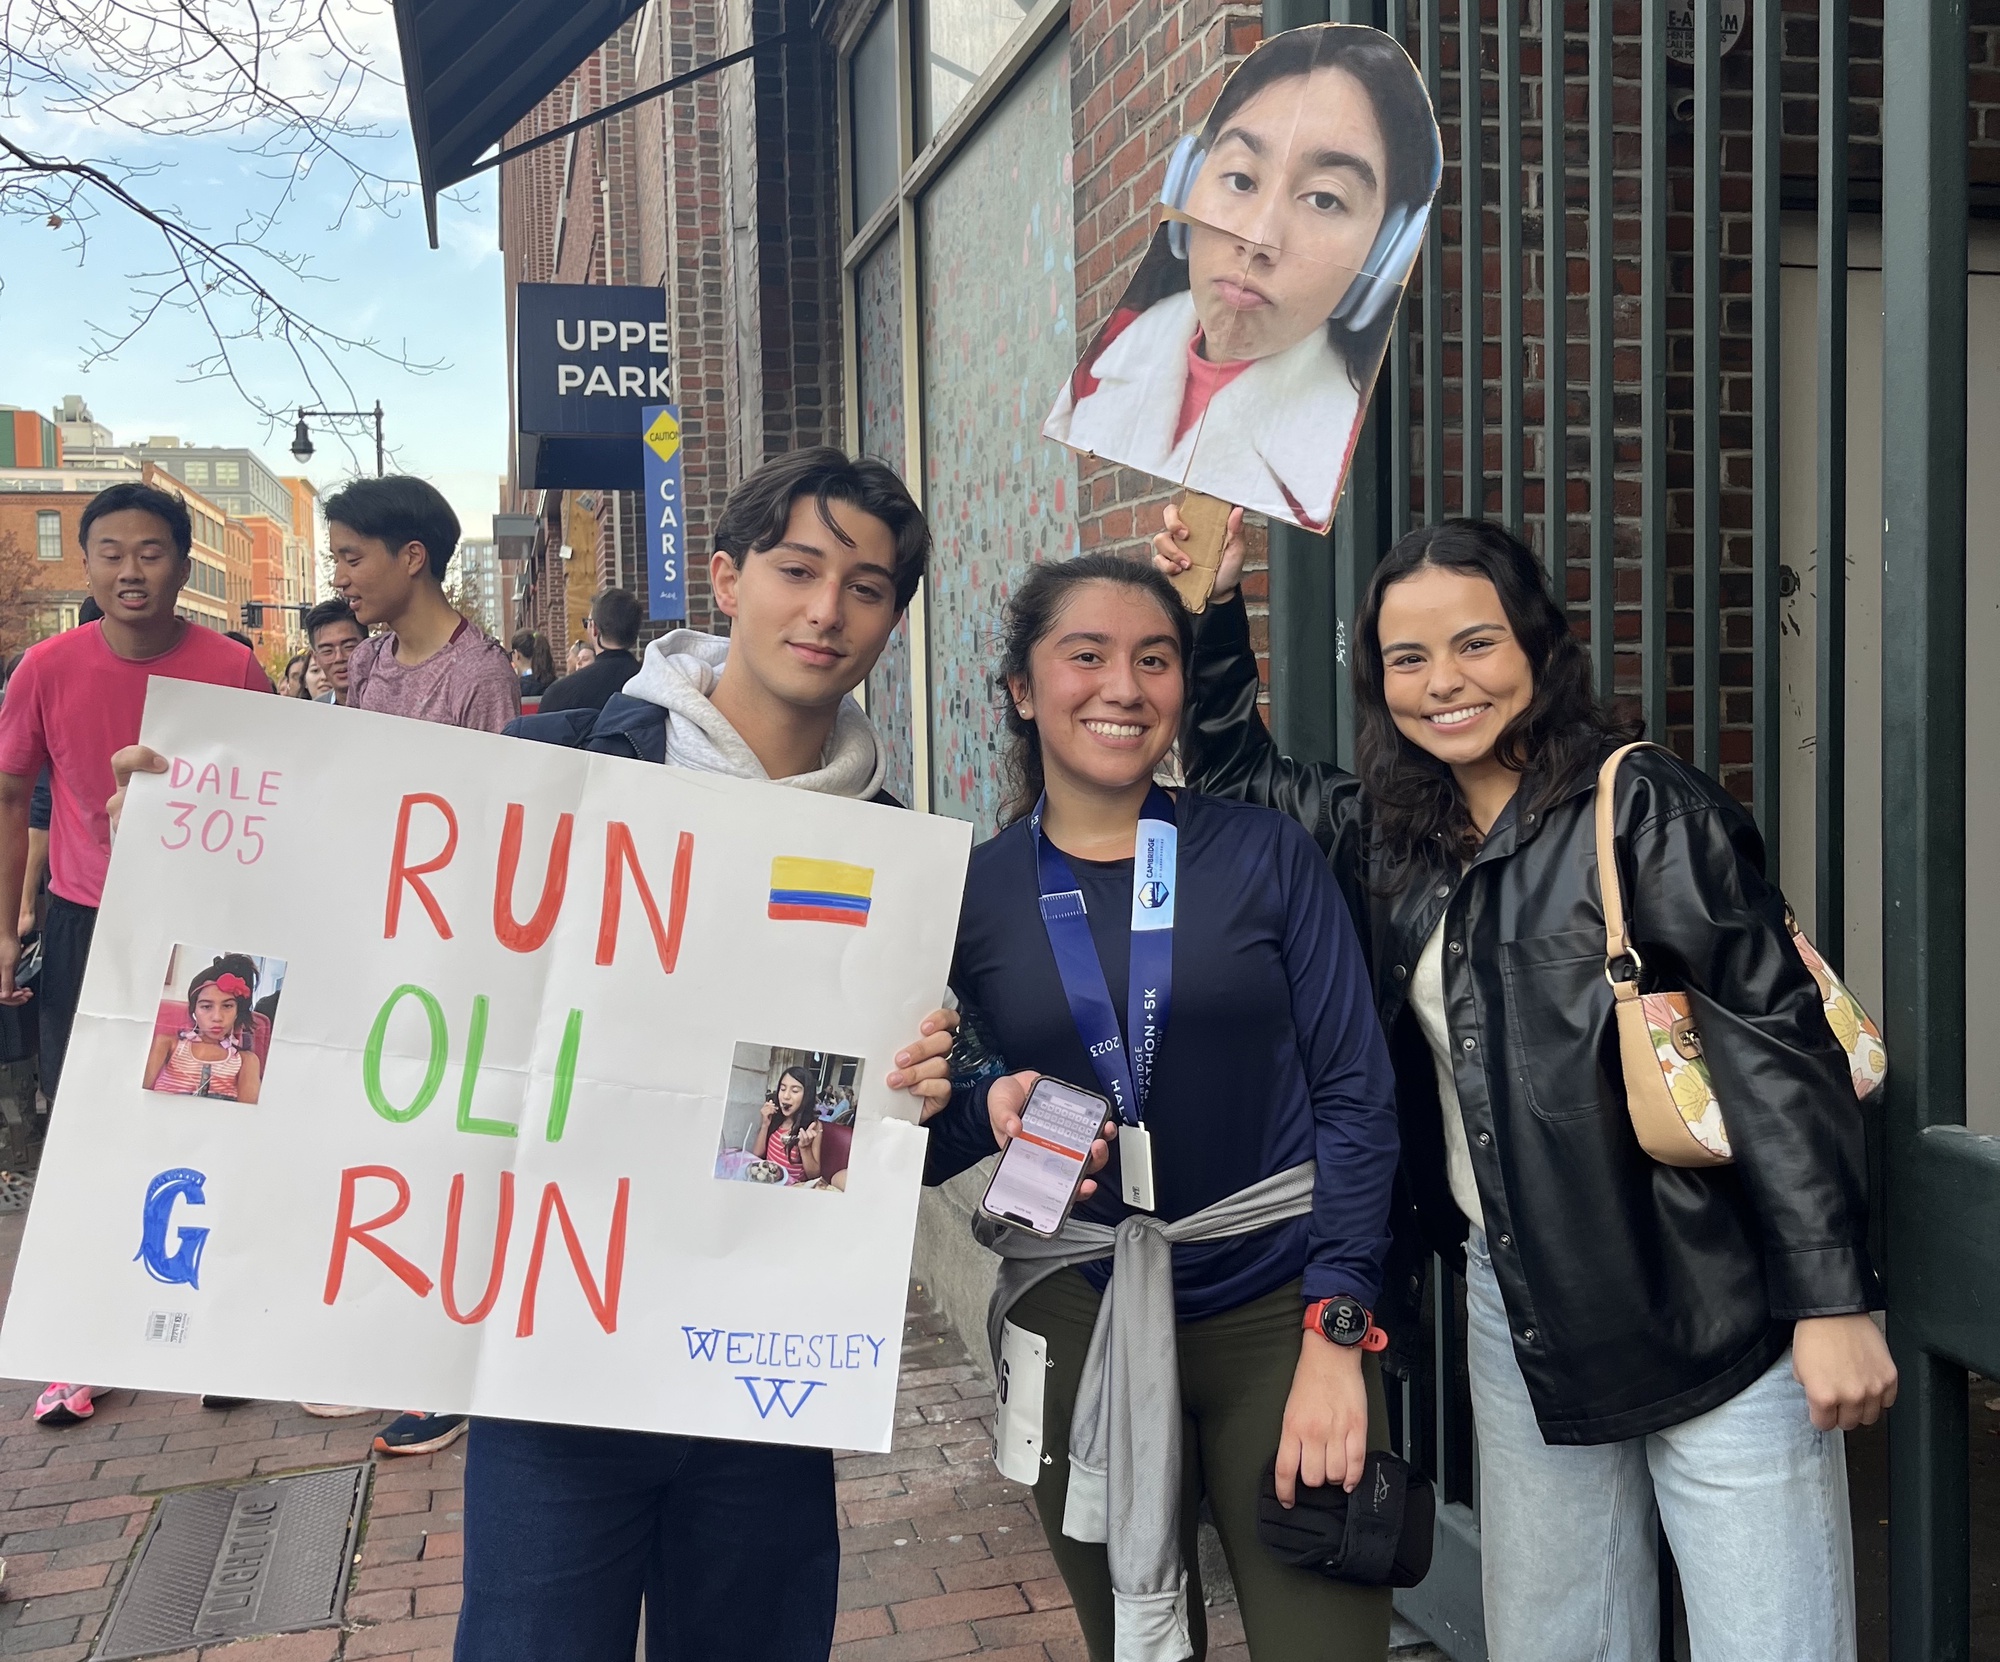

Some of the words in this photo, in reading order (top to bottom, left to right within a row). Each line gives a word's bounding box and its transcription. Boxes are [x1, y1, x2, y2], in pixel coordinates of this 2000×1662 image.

[660, 478, 678, 582] CARS
[169, 757, 282, 805] DALE
[161, 801, 267, 865] 305
[1146, 837, 1155, 879] CAMBRIDGE
[384, 793, 694, 974] RUN
[1144, 988, 1156, 1010] 5K
[363, 984, 583, 1142] OLI
[1089, 1036, 1120, 1058] 2023
[132, 1167, 210, 1290] G
[323, 1165, 630, 1337] RUN
[681, 1326, 886, 1368] WELLESLEY
[734, 1376, 828, 1419] W
[207, 1500, 278, 1614] LIGHTING
